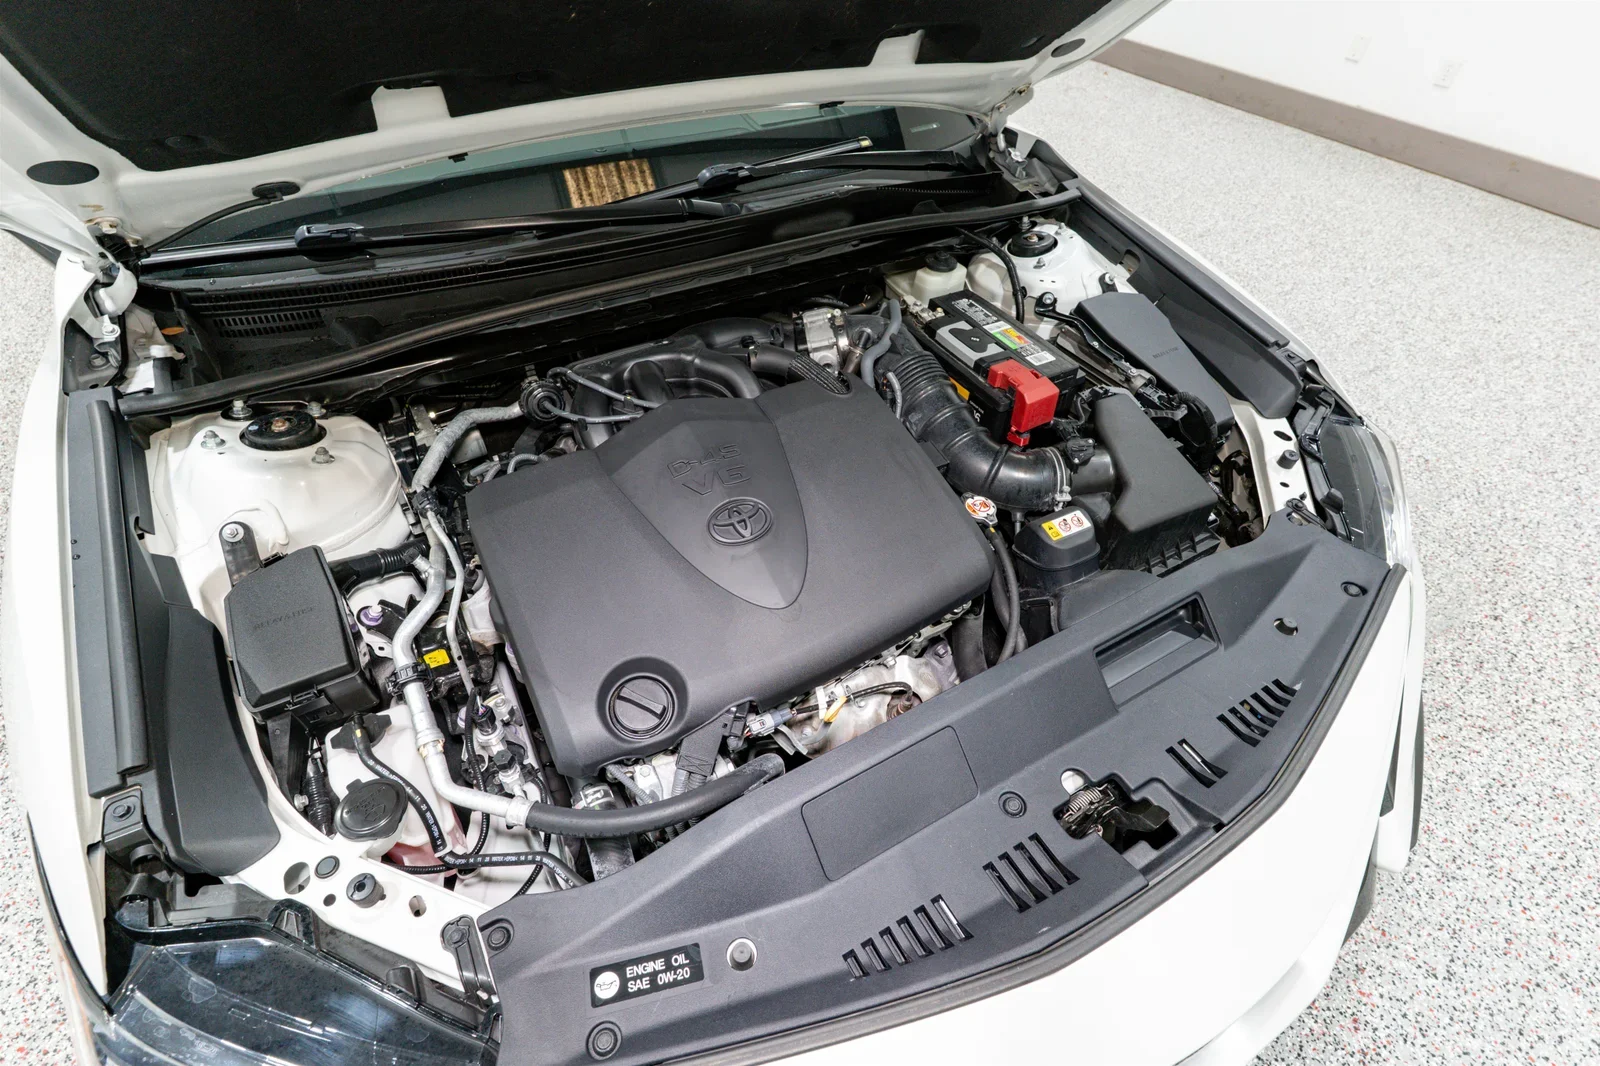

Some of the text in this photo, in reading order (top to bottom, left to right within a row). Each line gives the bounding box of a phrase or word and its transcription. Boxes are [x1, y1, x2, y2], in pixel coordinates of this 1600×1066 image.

[667, 444, 741, 478] D-4S
[681, 464, 751, 496] V6
[626, 953, 690, 978] ENGINE OIL
[627, 967, 690, 992] SAE 0W-20
